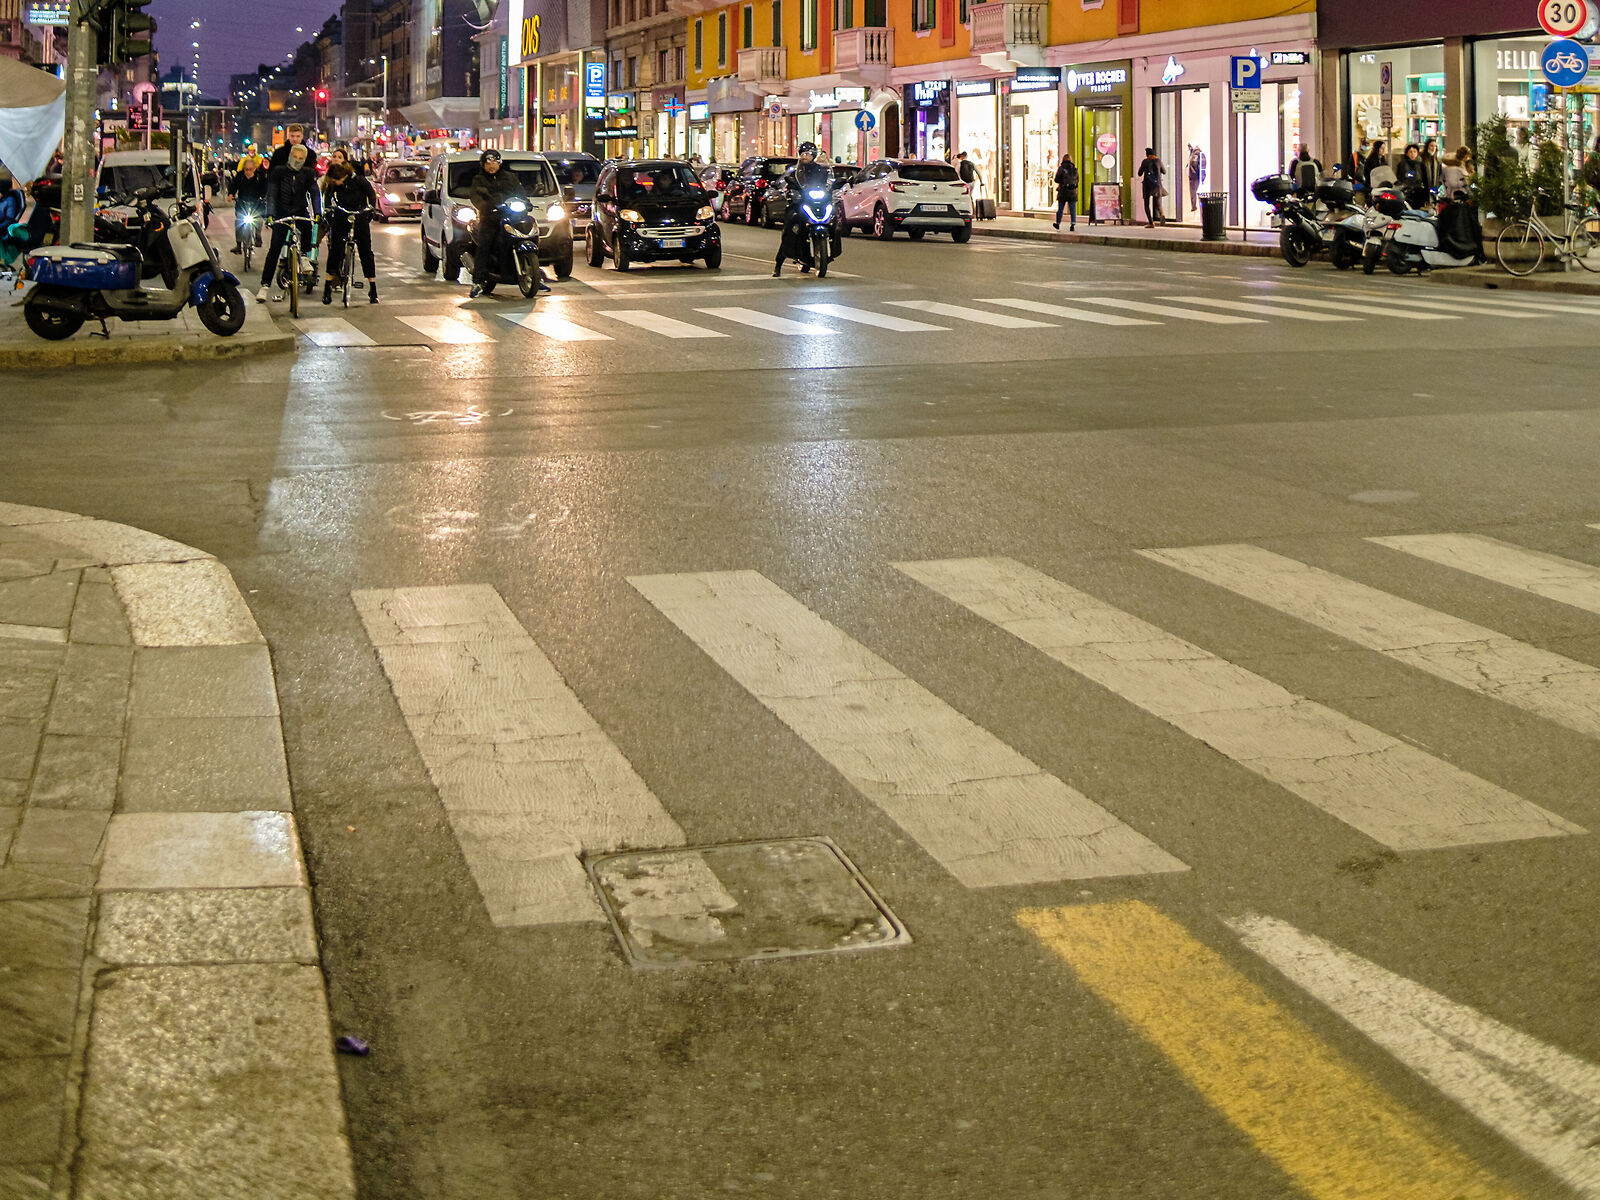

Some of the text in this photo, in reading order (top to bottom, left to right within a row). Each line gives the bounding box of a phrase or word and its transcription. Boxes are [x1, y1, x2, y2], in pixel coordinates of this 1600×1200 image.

[1550, 3, 1576, 24] 30
[522, 14, 540, 57] OVS
[591, 68, 602, 82] P
[1076, 72, 1095, 86] YVES
[1096, 69, 1126, 84] ROCHER
[1237, 59, 1257, 87] P
